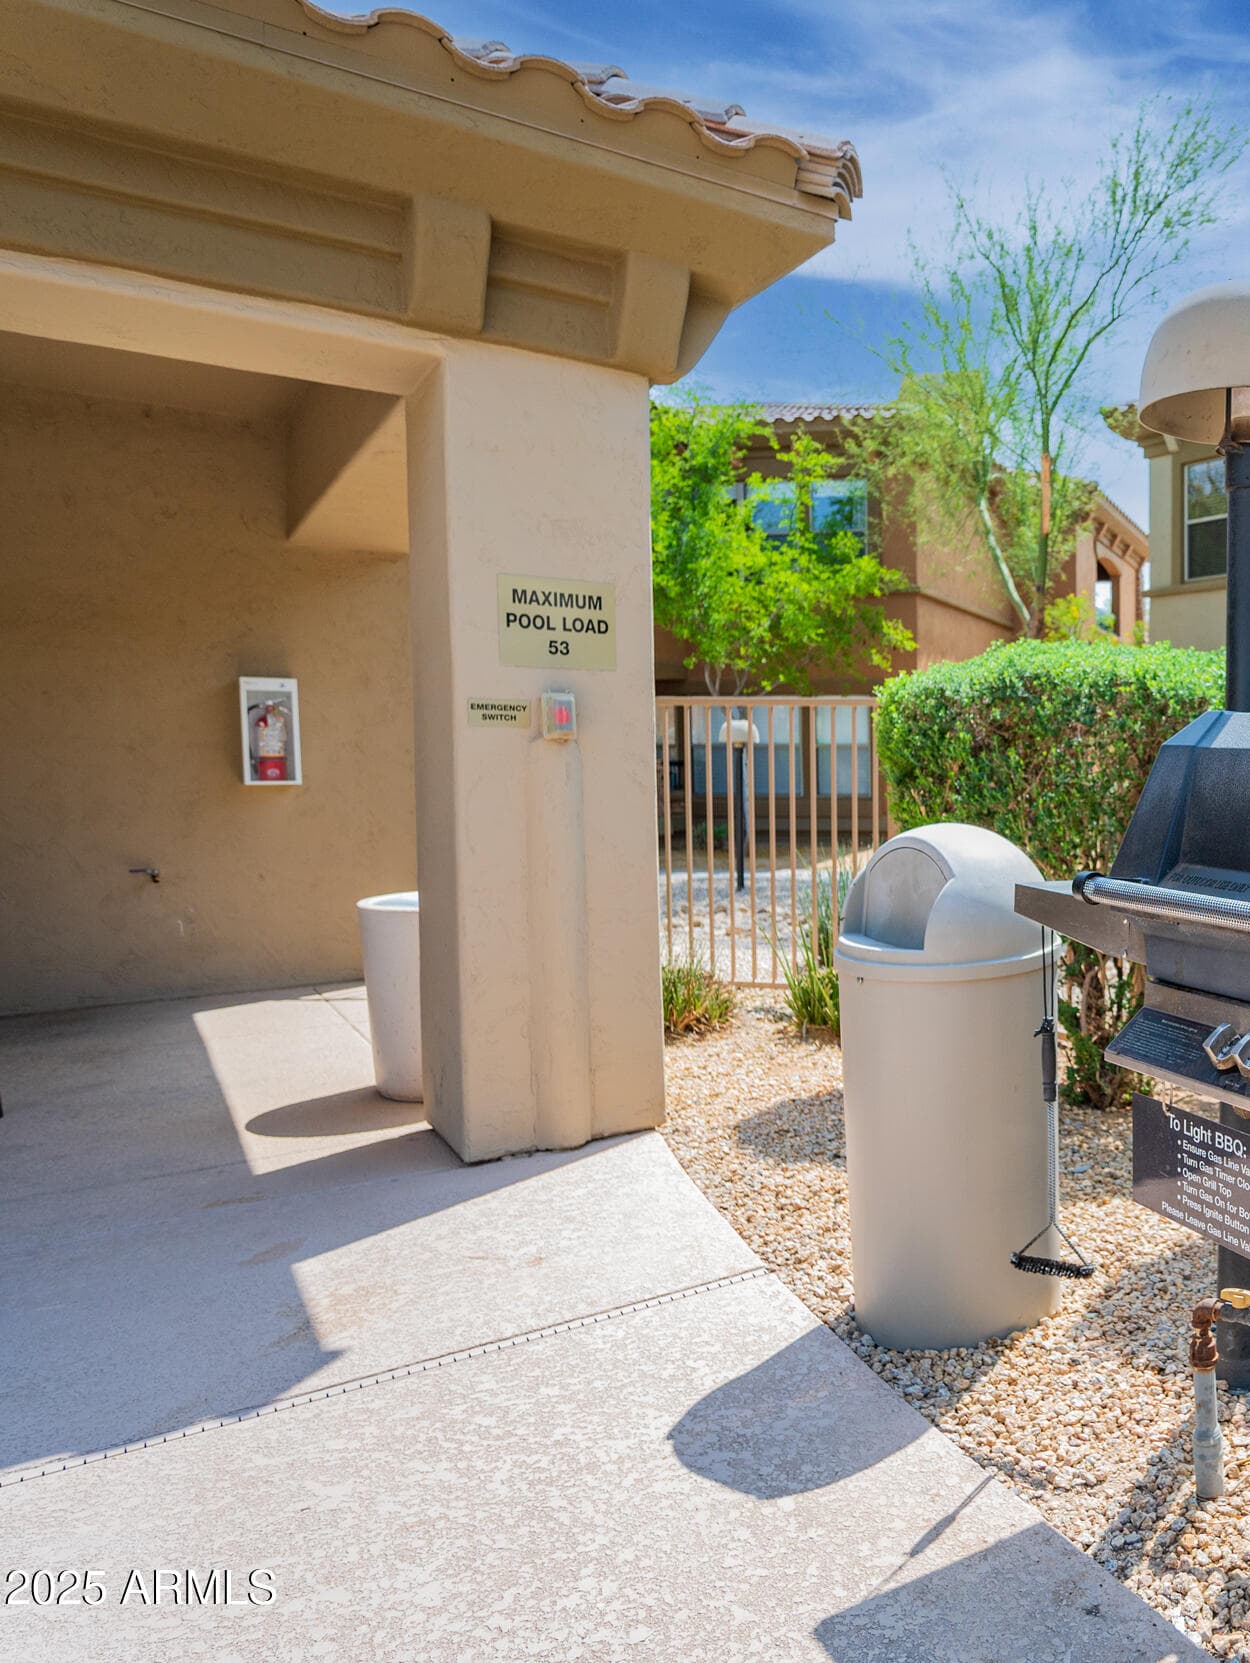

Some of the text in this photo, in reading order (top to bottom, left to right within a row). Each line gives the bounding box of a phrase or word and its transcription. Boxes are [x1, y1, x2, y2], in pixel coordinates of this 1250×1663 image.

[512, 588, 602, 611] MAXIMUM
[506, 612, 609, 634] POOL LOAD
[548, 640, 570, 655] 53
[470, 703, 527, 712] EMERGENCY
[482, 713, 517, 721] SWITCH
[1168, 1113, 1247, 1158] To Light BBQ:
[1182, 1140, 1206, 1158] Ensure
[1207, 1150, 1222, 1164] Gas
[1223, 1156, 1239, 1171] Line
[1182, 1153, 1198, 1168] Turn
[1199, 1161, 1214, 1175] Gas
[1214, 1167, 1236, 1184] Timer
[1182, 1167, 1232, 1198] Open Grill Top
[1182, 1181, 1198, 1196] Turn
[1199, 1189, 1213, 1203] Gas
[1214, 1196, 1225, 1209] On
[1226, 1202, 1238, 1214] for
[1161, 1201, 1184, 1219] Please
[1185, 1212, 1206, 1230] Leave
[1207, 1223, 1221, 1238] Gas
[1223, 1230, 1239, 1246] Line
[1182, 1195, 1250, 1235] Press Ignite Button
